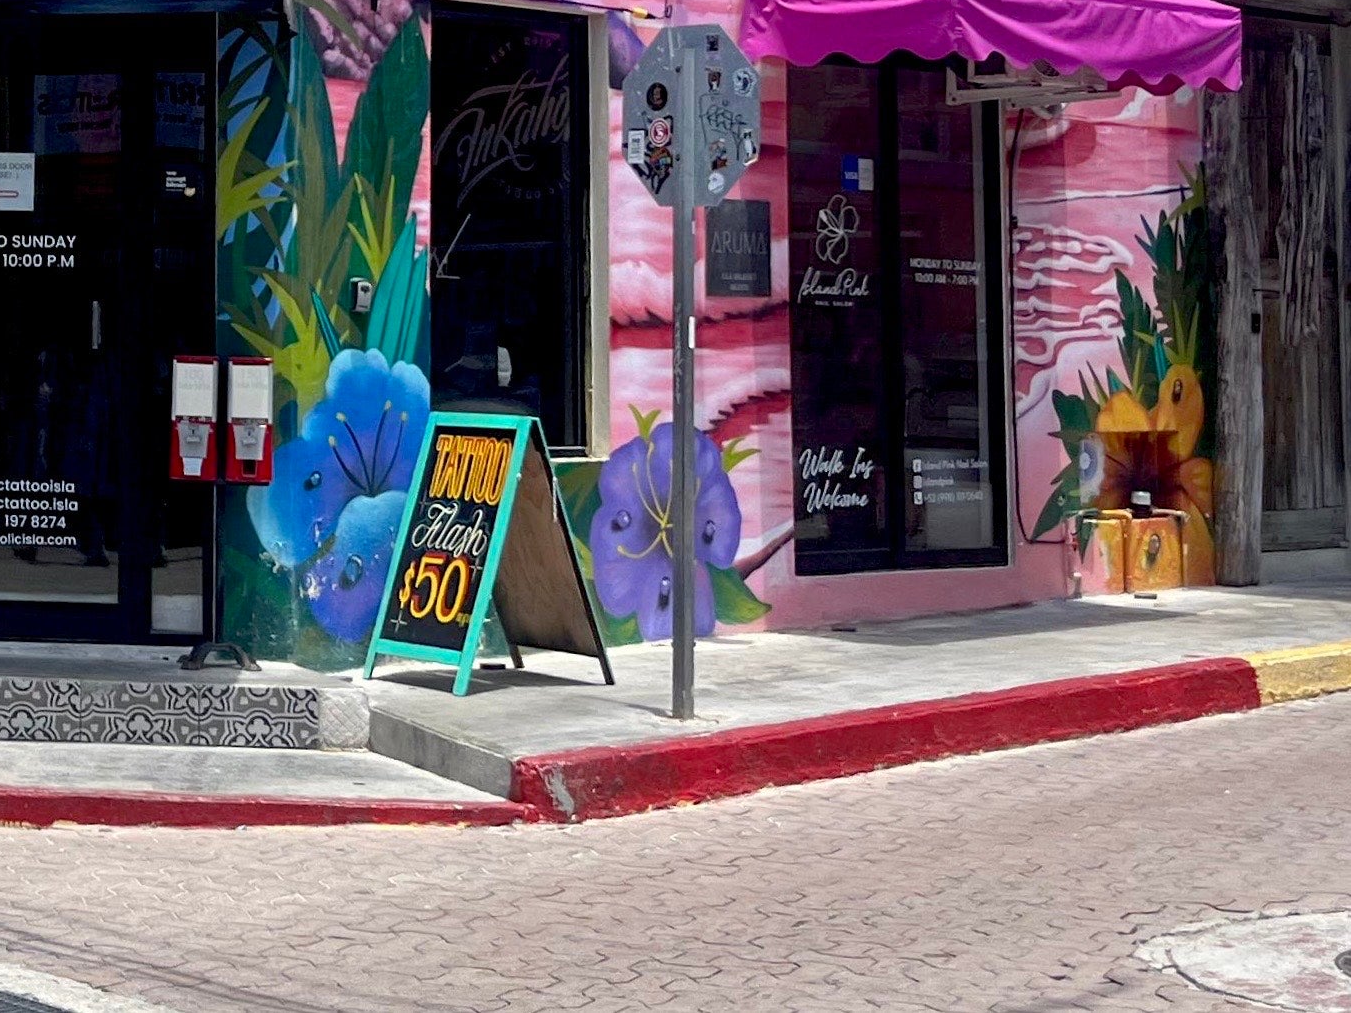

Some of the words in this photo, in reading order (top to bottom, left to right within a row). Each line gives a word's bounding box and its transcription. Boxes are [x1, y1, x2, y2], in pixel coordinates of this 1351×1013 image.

[9, 163, 33, 171] DOOR
[12, 234, 76, 248] SUNDAY
[2, 253, 42, 268] 10:00
[47, 254, 75, 268] P.M
[909, 258, 941, 269] MONDAY
[942, 259, 953, 270] TO
[953, 259, 982, 271] SUNDAY
[914, 272, 934, 283] 10:00
[935, 273, 946, 284] AM
[429, 434, 513, 506] TATTOO
[799, 446, 845, 479] Walk
[849, 447, 875, 479] Ins
[803, 479, 870, 513] Welcome
[4, 514, 27, 527] 197
[31, 514, 67, 529] 8274
[412, 503, 487, 557] Flash
[399, 552, 472, 624] $50
